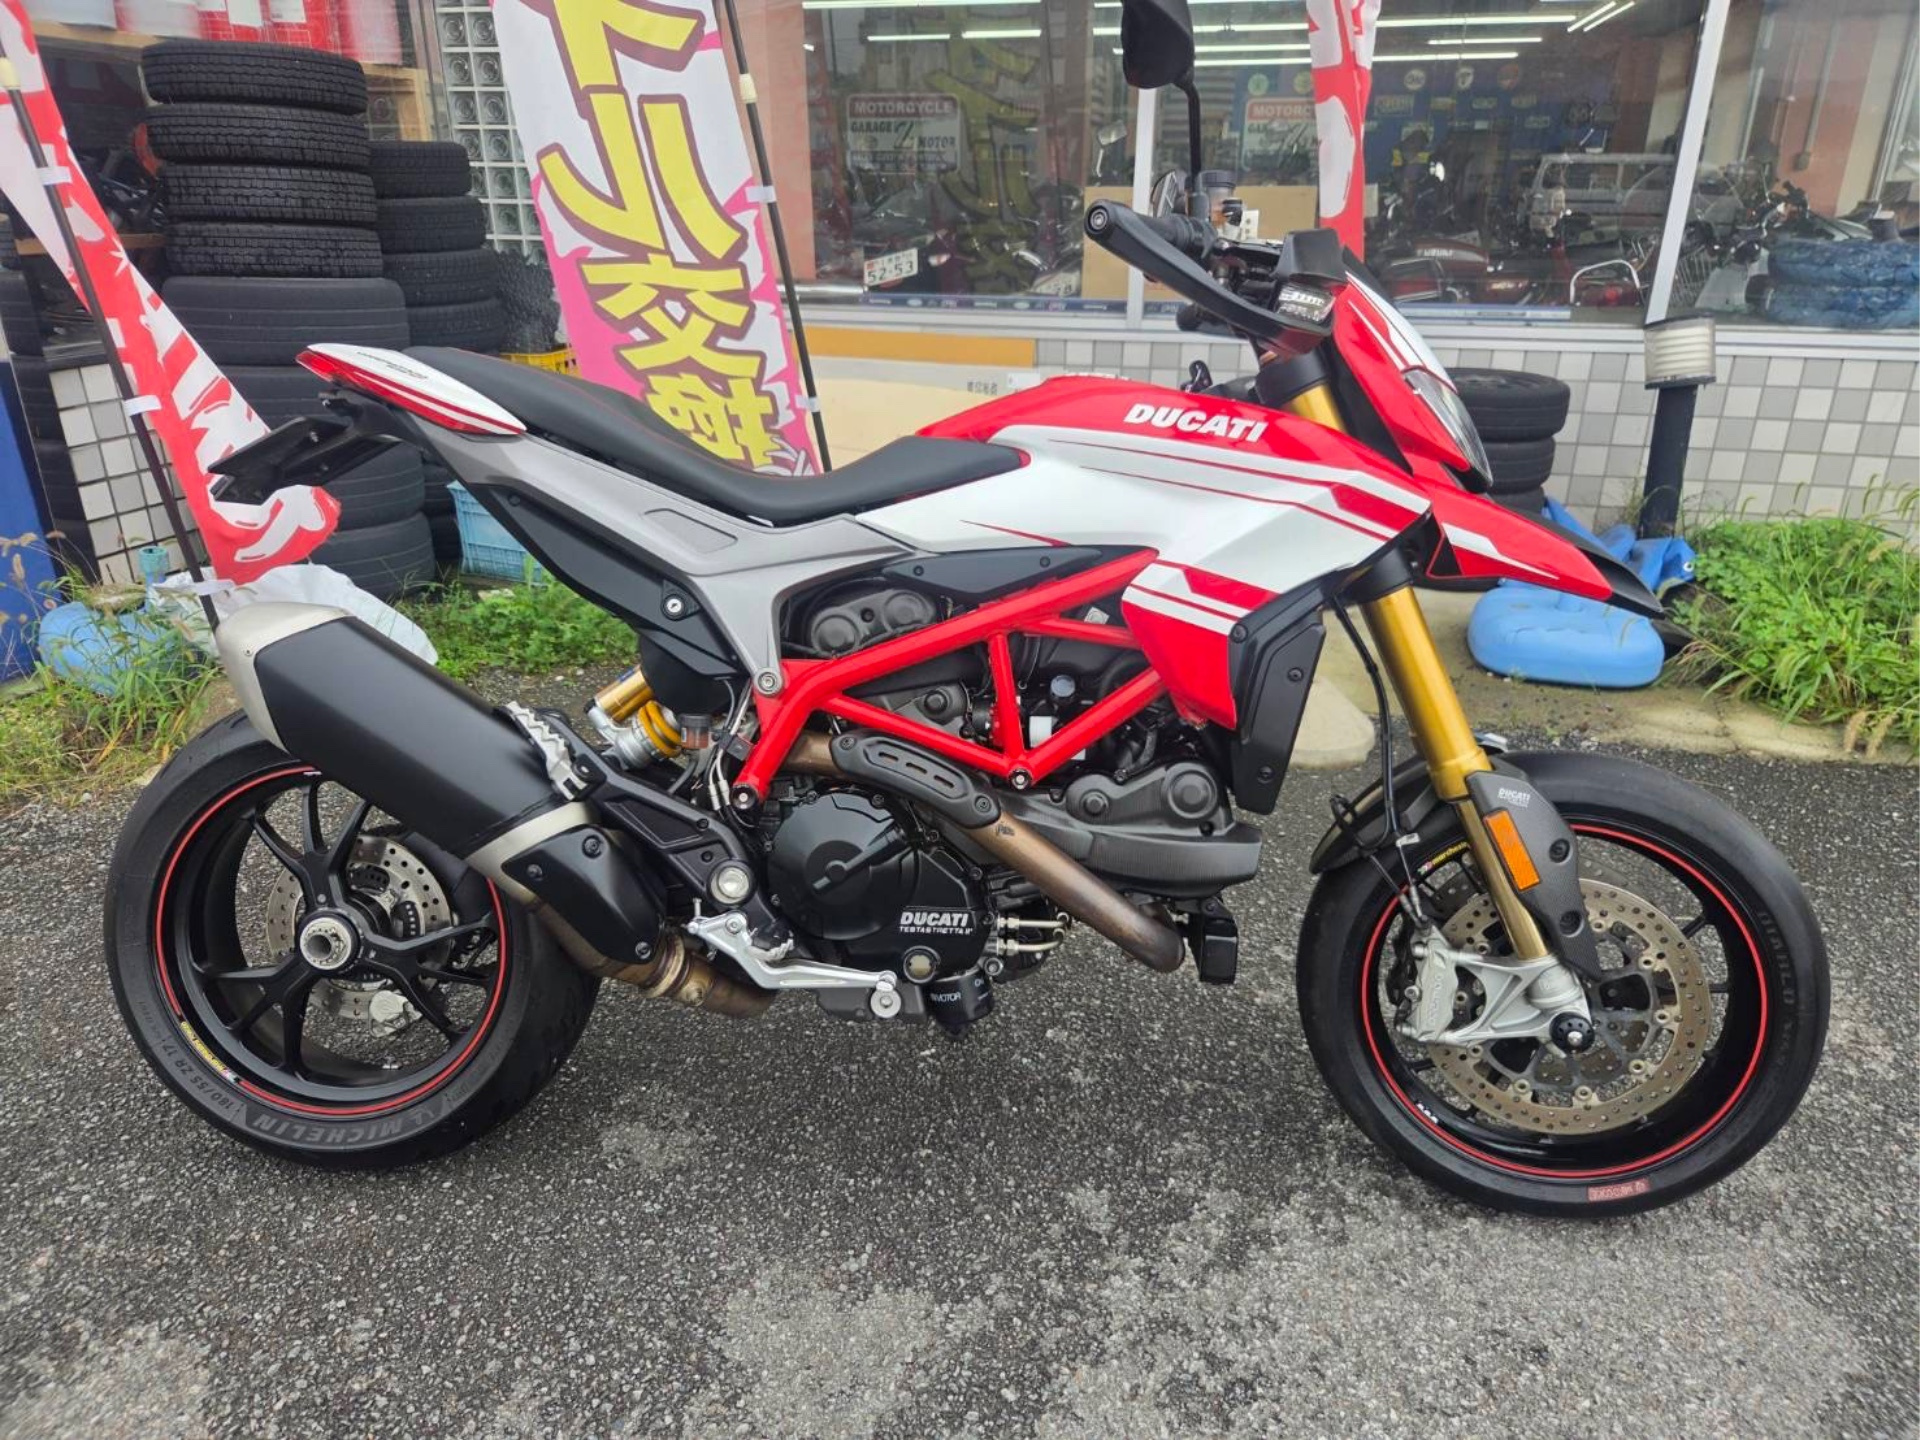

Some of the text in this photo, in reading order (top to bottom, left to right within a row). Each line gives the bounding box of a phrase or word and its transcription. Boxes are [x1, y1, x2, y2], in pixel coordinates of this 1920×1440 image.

[854, 102, 953, 114] MOTORCYCLE
[1252, 104, 1312, 118] MOTORC
[1124, 403, 1269, 442] DUCATI
[900, 911, 969, 927] DUCATI
[252, 1113, 401, 1144] MICHELIN
